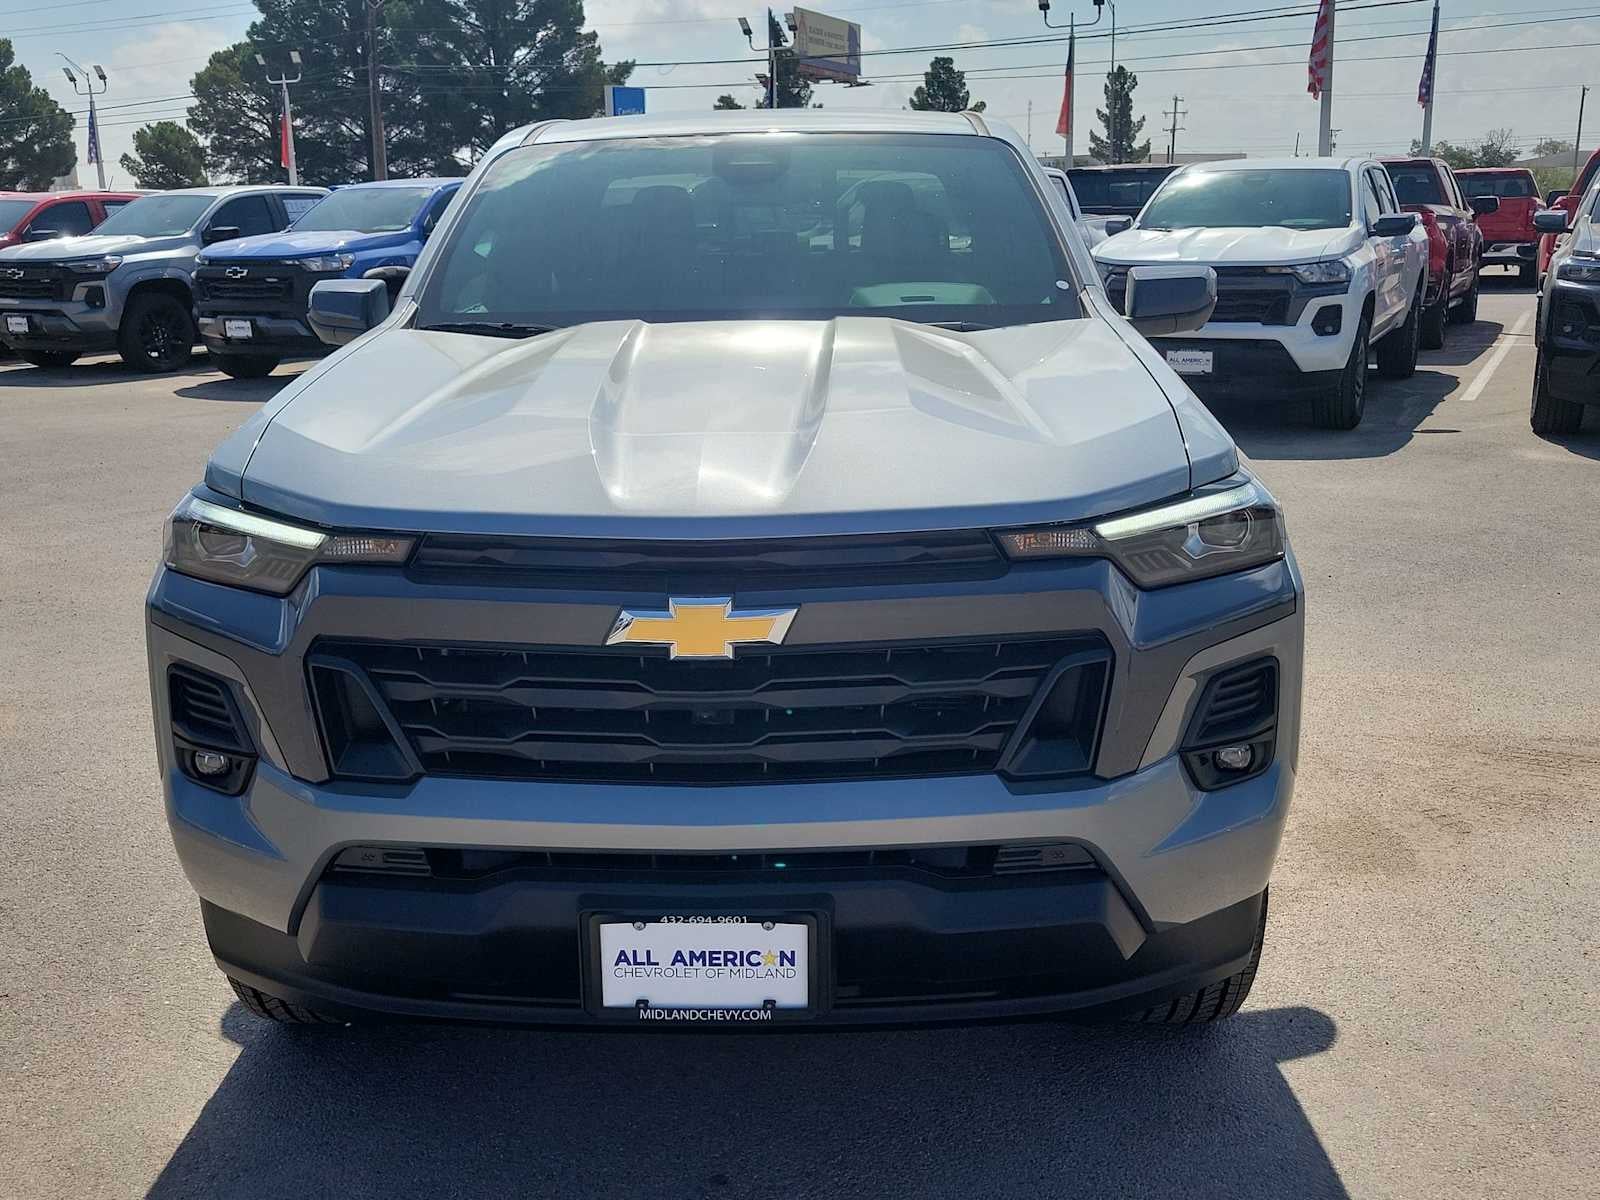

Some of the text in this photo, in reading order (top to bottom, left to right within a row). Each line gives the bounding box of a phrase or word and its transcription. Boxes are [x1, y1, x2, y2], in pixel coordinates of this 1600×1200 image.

[660, 915, 749, 924] 432-694-9601
[614, 949, 660, 967] ALL
[613, 967, 796, 979] CHEVROLET OF MIDLAND
[638, 1009, 772, 1021] MIDLANDCHEVY.COM
